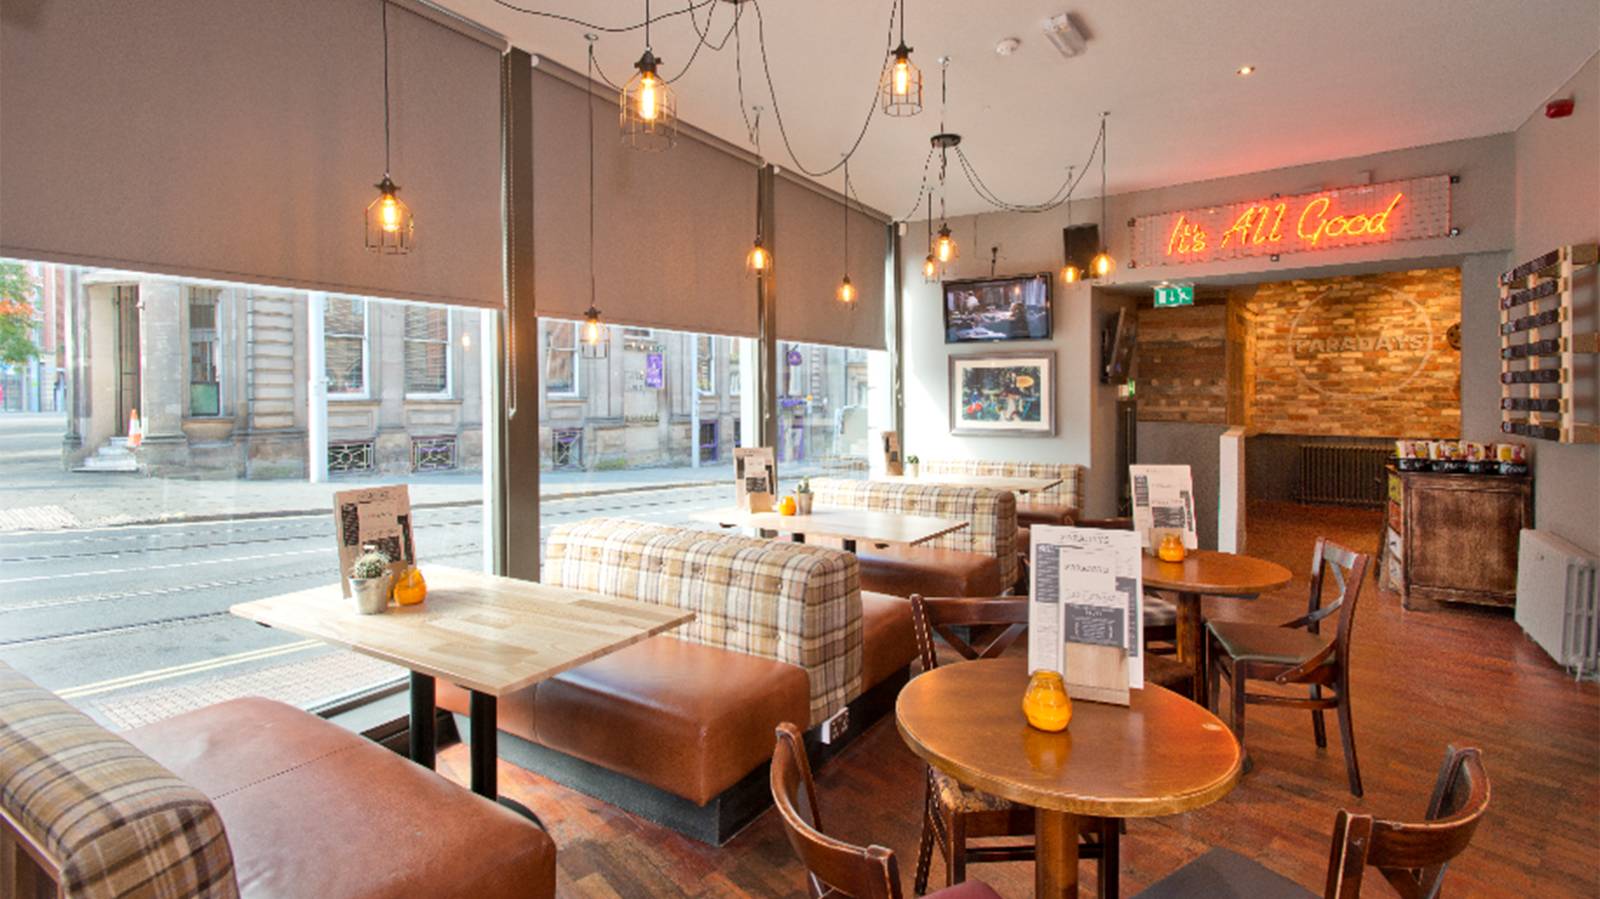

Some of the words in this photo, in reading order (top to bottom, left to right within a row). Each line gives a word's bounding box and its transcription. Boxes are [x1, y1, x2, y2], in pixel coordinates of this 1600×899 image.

[1167, 215, 1206, 255] It's
[1221, 203, 1286, 248] All
[1297, 193, 1402, 245] Good
